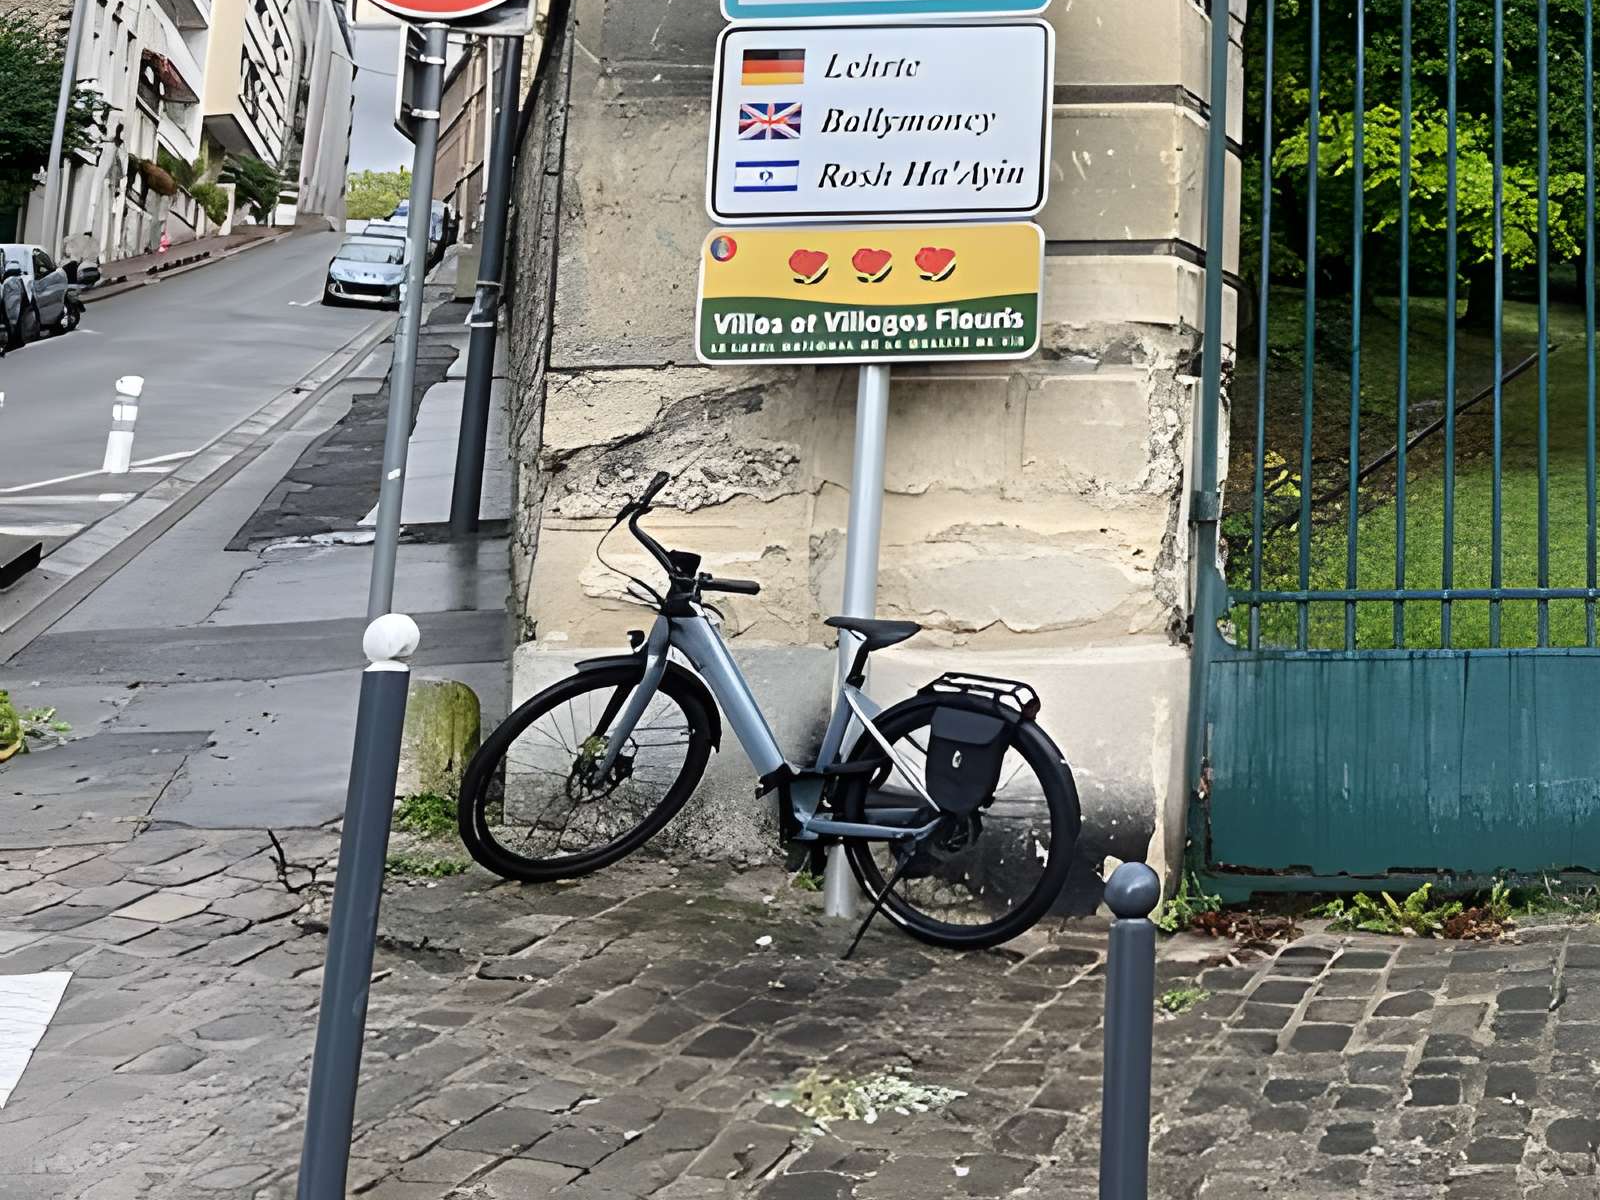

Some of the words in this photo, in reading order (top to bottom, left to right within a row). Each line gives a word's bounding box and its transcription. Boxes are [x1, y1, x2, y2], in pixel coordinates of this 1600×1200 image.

[824, 54, 921, 79] Lehrte
[821, 107, 997, 139] Ballymoney
[818, 162, 893, 188] Rosh
[903, 159, 1025, 192] Ha'Ayin
[713, 312, 783, 335] Villes
[790, 314, 817, 333] et
[824, 310, 928, 337] Villages
[936, 307, 1025, 331] Fleuris
